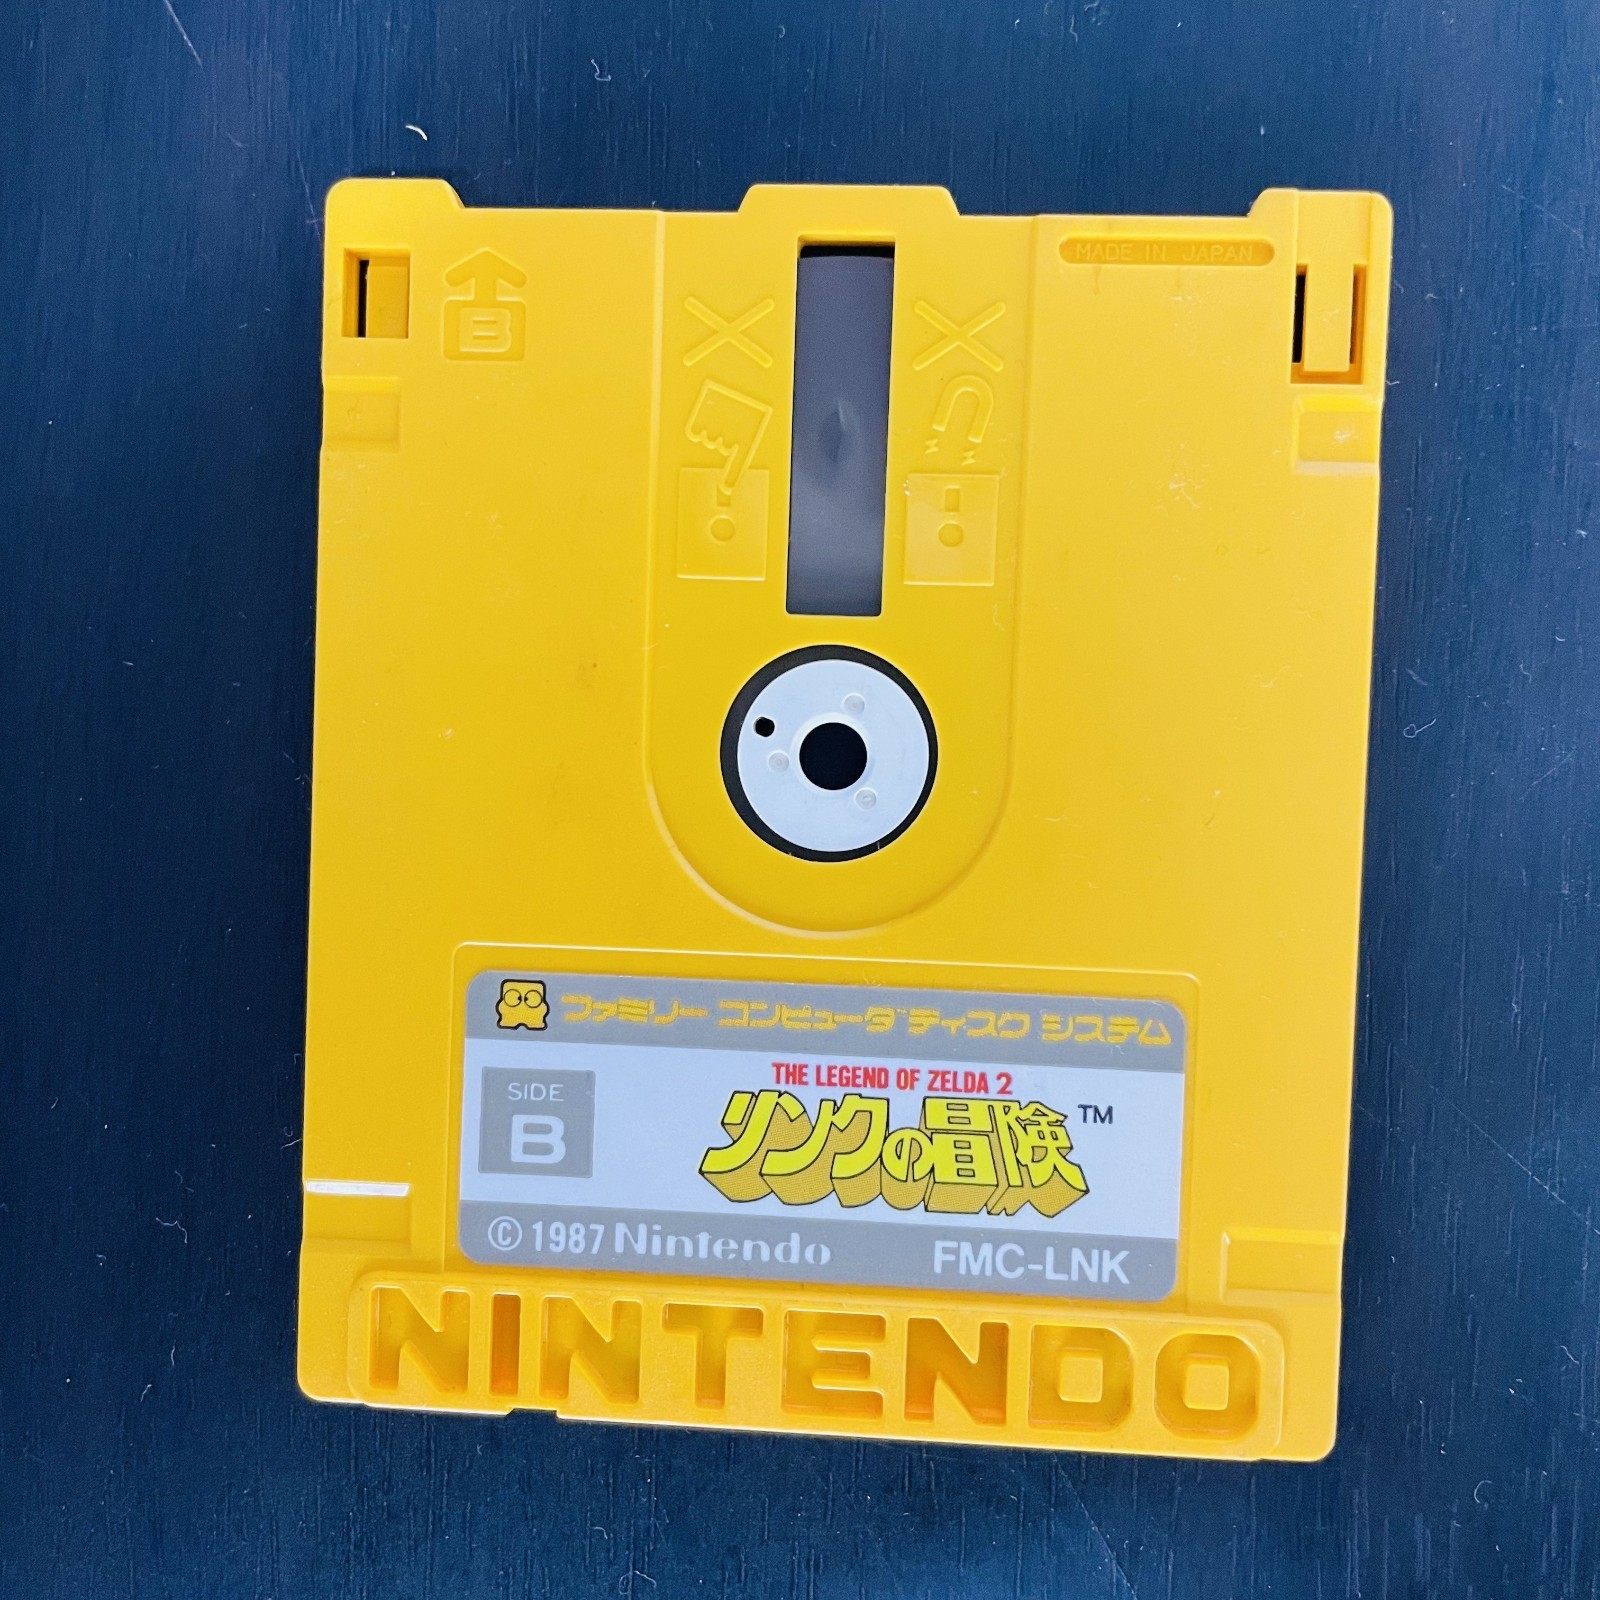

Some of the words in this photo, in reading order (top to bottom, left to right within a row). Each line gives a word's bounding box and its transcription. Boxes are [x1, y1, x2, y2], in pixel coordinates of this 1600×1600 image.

[1075, 243, 1133, 261] MADE
[1145, 244, 1166, 261] IN
[1182, 245, 1253, 262] JAPAN
[561, 995, 708, 1025] ファミリー
[1041, 1014, 1172, 1045] システム
[508, 1082, 565, 1102] SIDE
[772, 1063, 809, 1087] THE
[815, 1065, 889, 1089] LEGEND
[896, 1068, 920, 1090] OF
[928, 1070, 989, 1094] ZELDA
[996, 1072, 1013, 1095] 2
[510, 1114, 567, 1165] B
[698, 1089, 1090, 1218] リンクの冒険
[532, 1221, 605, 1255] 1987
[614, 1222, 832, 1266] Nintendo
[932, 1239, 1131, 1285] FMC-LNK
[367, 1284, 1260, 1441] NINTENDO
